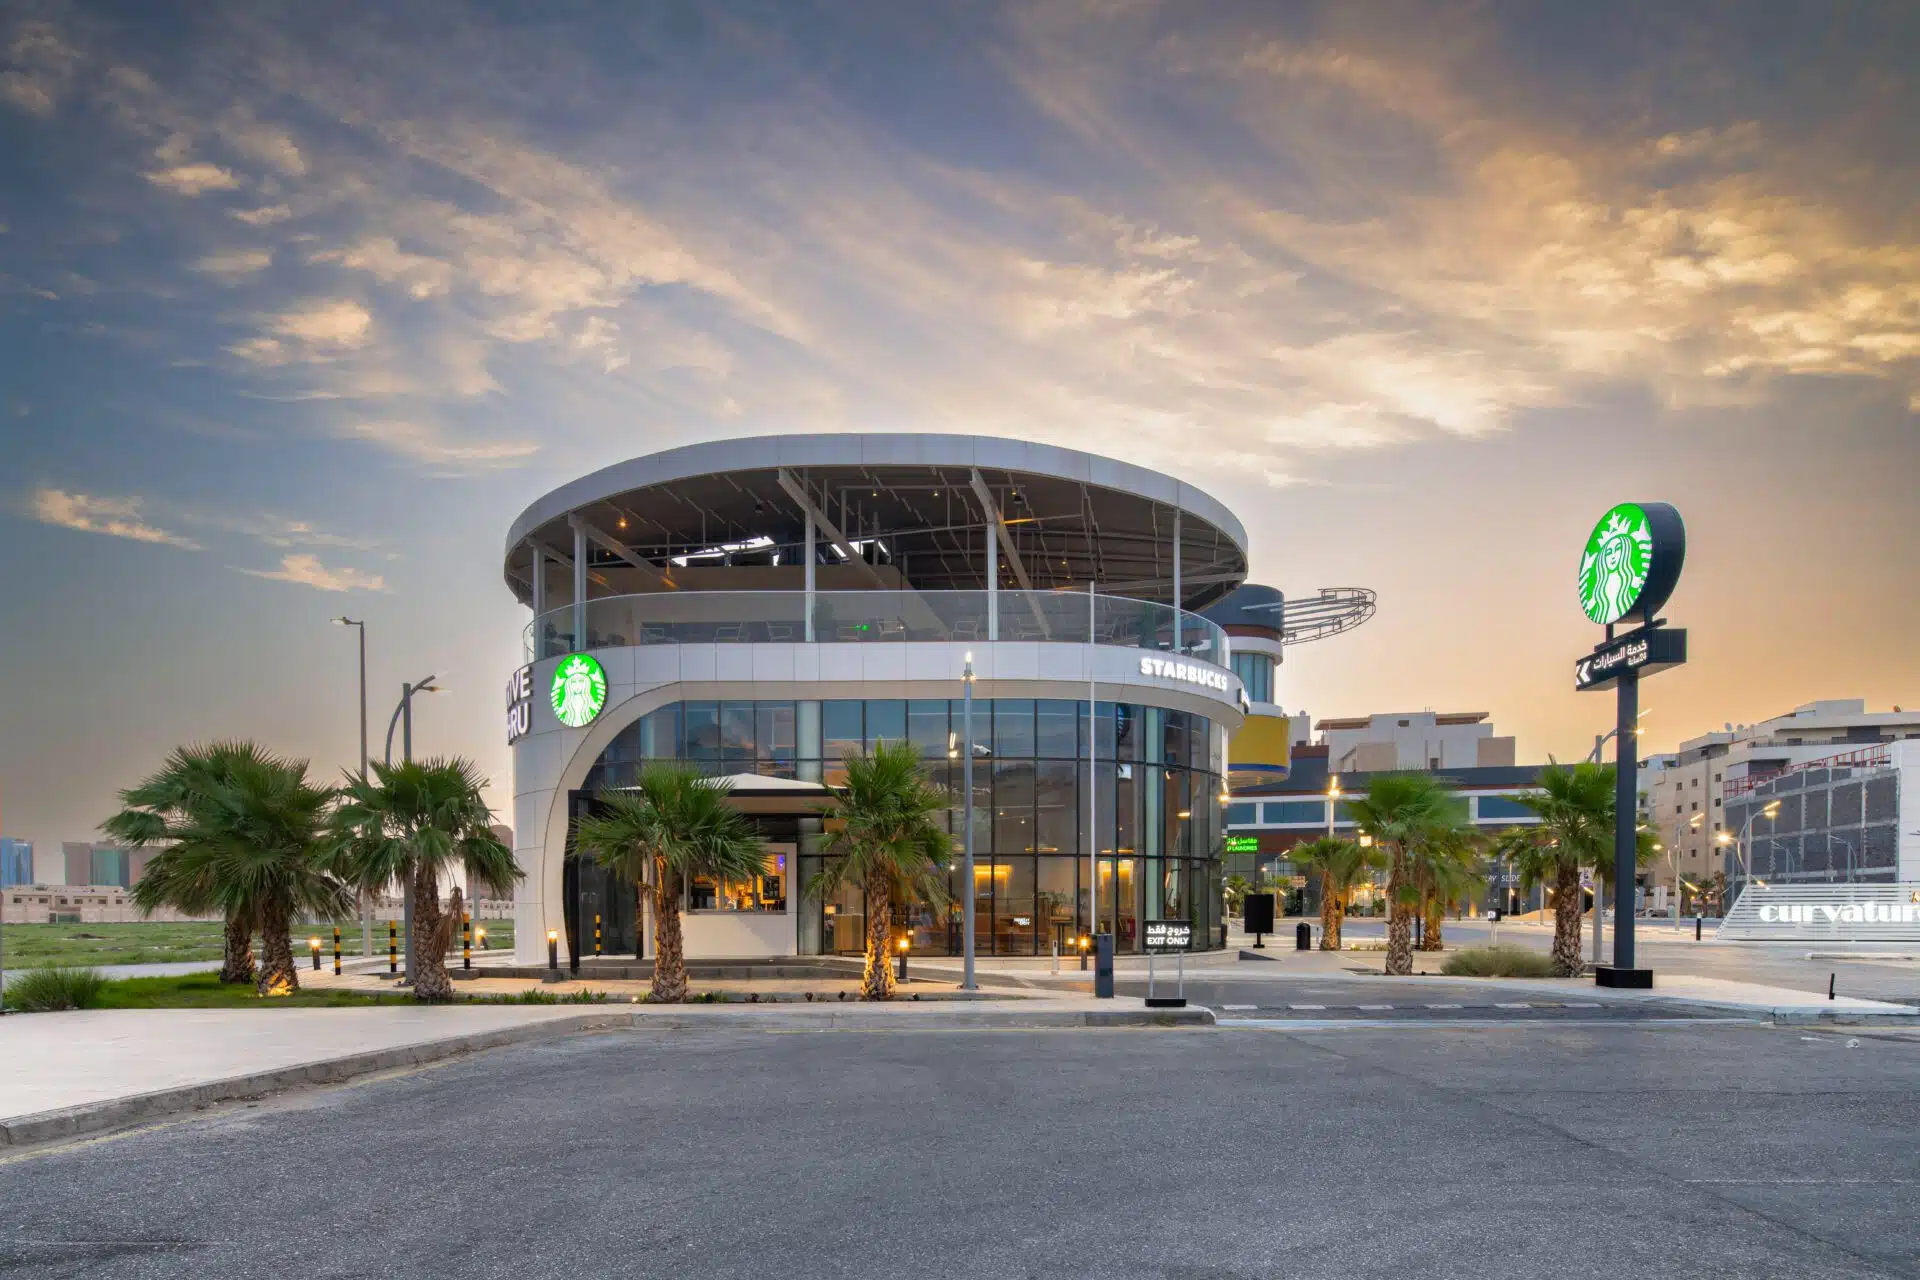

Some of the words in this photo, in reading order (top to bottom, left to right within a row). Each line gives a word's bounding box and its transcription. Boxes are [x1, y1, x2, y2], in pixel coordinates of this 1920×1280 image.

[1626, 640, 1648, 656] خدمة
[1593, 646, 1626, 670] السيارات
[1140, 658, 1227, 691] STARBUCKS
[1501, 874, 1521, 882] SLDE
[1147, 924, 1167, 935] فقط
[1167, 926, 1190, 936] خروج
[1147, 936, 1165, 945] EXIT
[1167, 936, 1189, 945] ONLY
